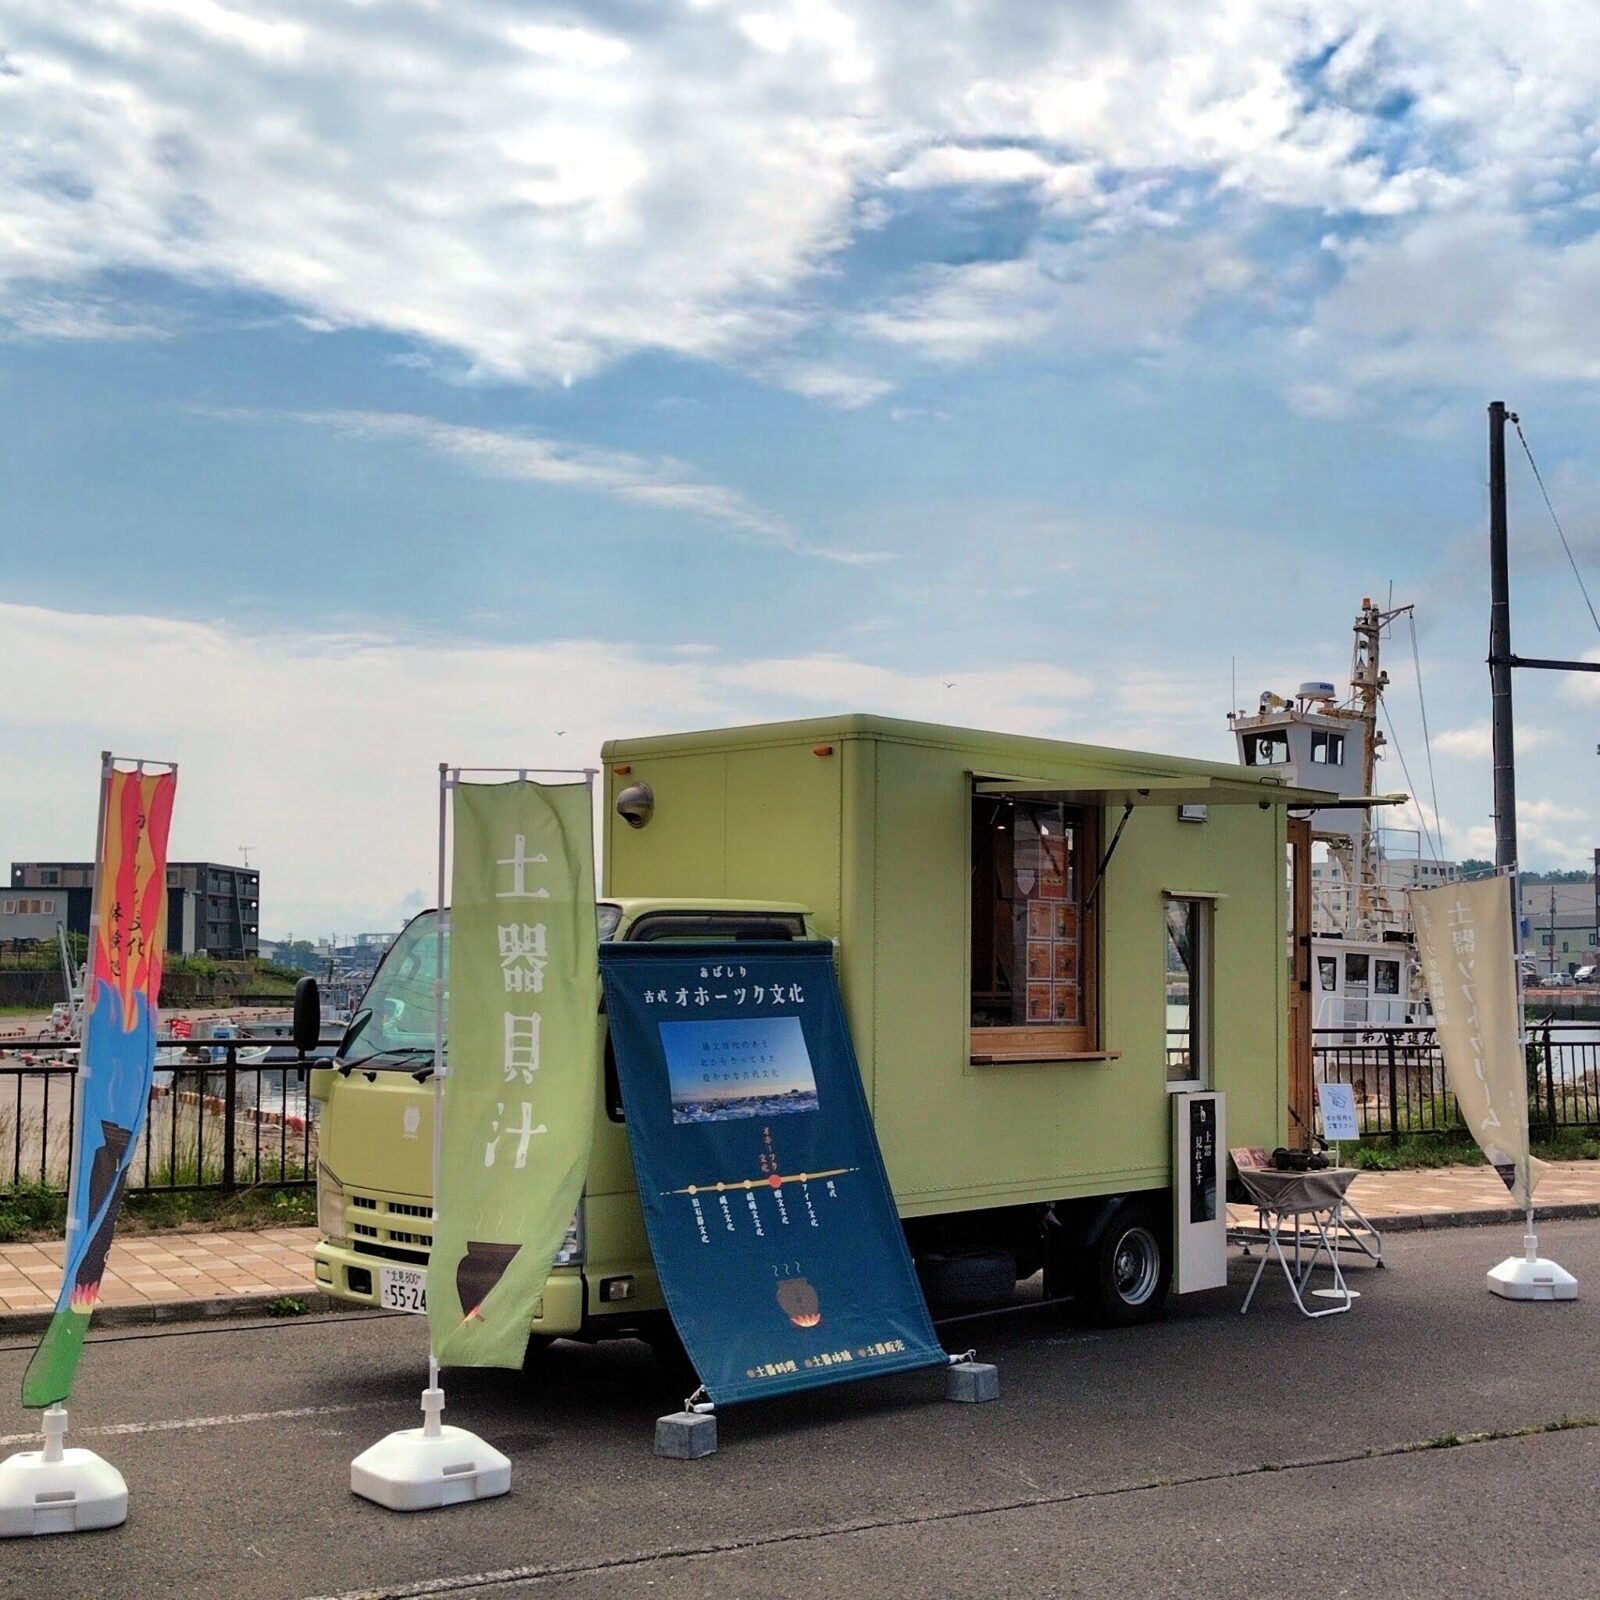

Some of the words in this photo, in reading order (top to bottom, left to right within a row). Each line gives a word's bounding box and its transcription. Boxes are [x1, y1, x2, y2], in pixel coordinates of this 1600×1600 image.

[700, 965, 747, 978] あばしり
[483, 833, 551, 1169] 土器貝汁
[643, 989, 669, 1004] 古代
[674, 983, 805, 1007] オホーツク文化
[390, 1284, 427, 1312] 55-24
